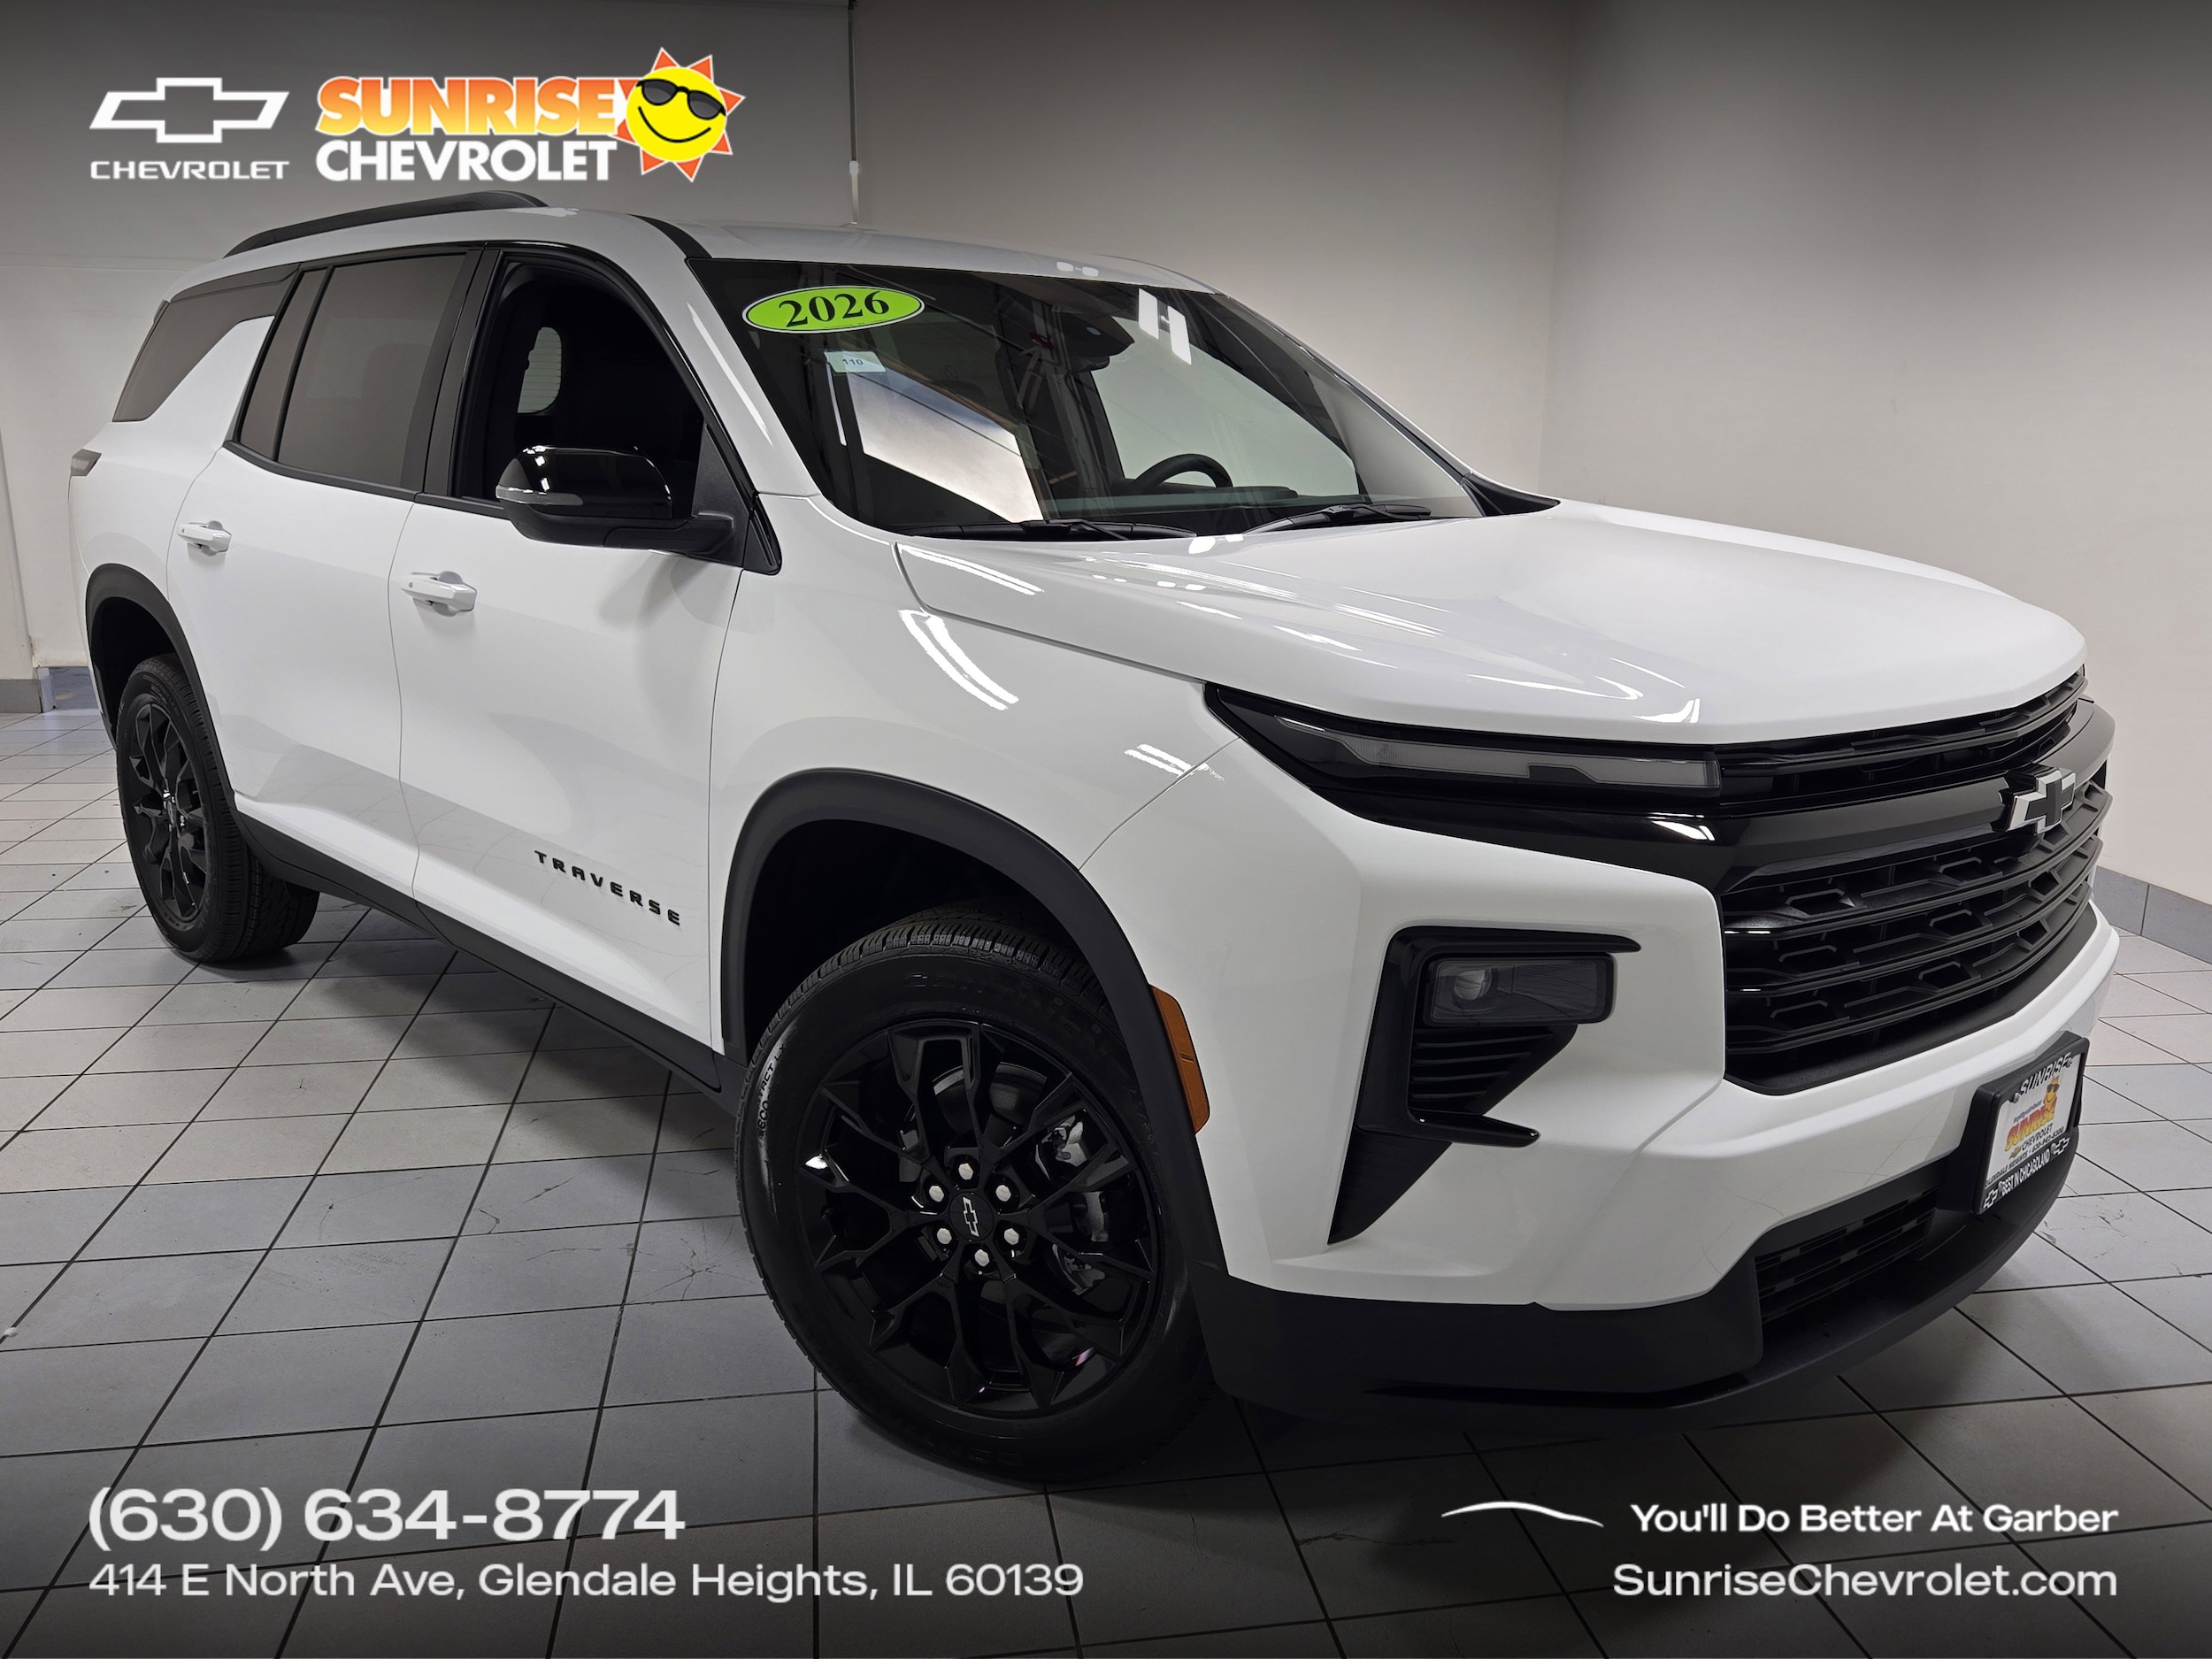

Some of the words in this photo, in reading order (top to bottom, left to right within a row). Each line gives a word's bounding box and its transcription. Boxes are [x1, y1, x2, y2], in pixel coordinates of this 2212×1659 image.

[778, 290, 890, 328] 2026
[534, 849, 680, 926] TRAVERSE
[2020, 1051, 2072, 1096] SUNRISE
[2003, 1101, 2056, 1152] SUNRISE
[2022, 1123, 2054, 1151] CHEVROLET
